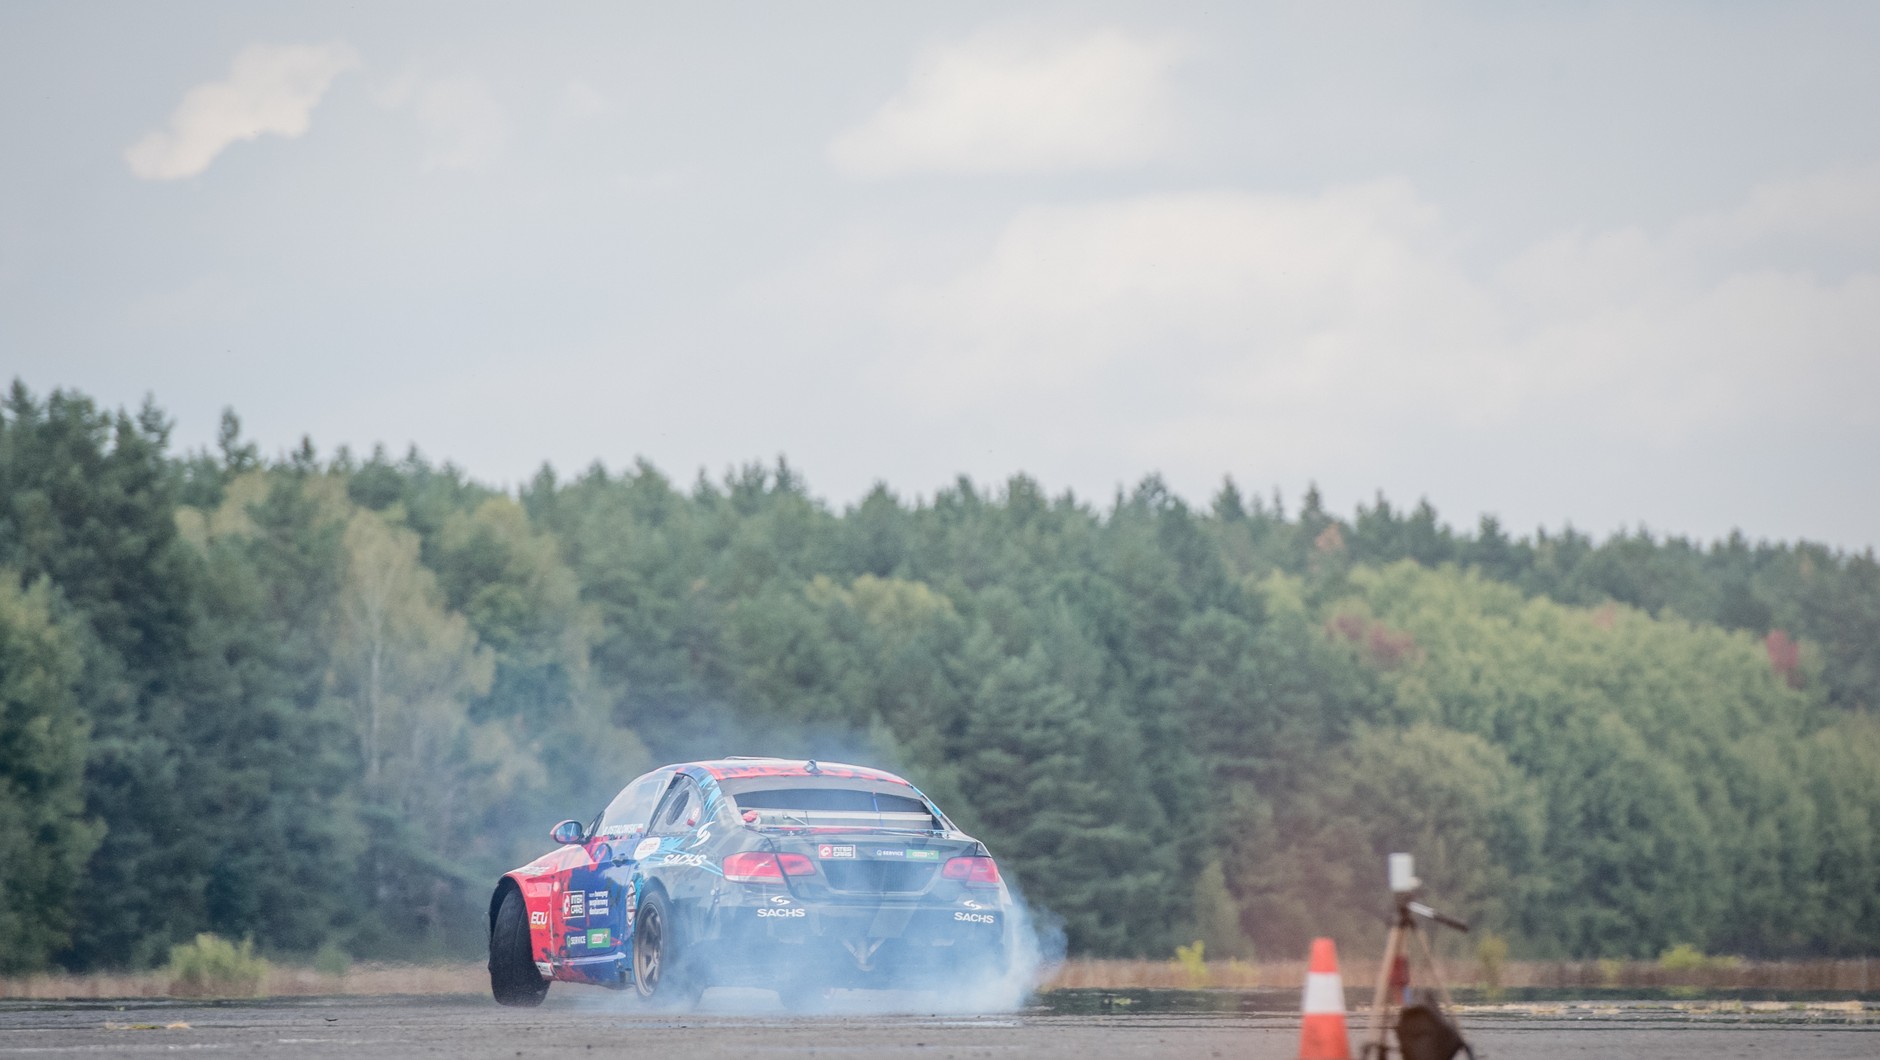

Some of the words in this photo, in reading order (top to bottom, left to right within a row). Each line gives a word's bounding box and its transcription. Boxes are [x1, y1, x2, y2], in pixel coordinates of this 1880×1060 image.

[662, 854, 707, 866] SACHS
[570, 894, 583, 902] INTER
[570, 904, 583, 914] CARS
[757, 908, 806, 918] SACHS
[531, 911, 548, 925] ECU
[953, 911, 995, 924] SACHS
[570, 935, 586, 945] SERVICE
